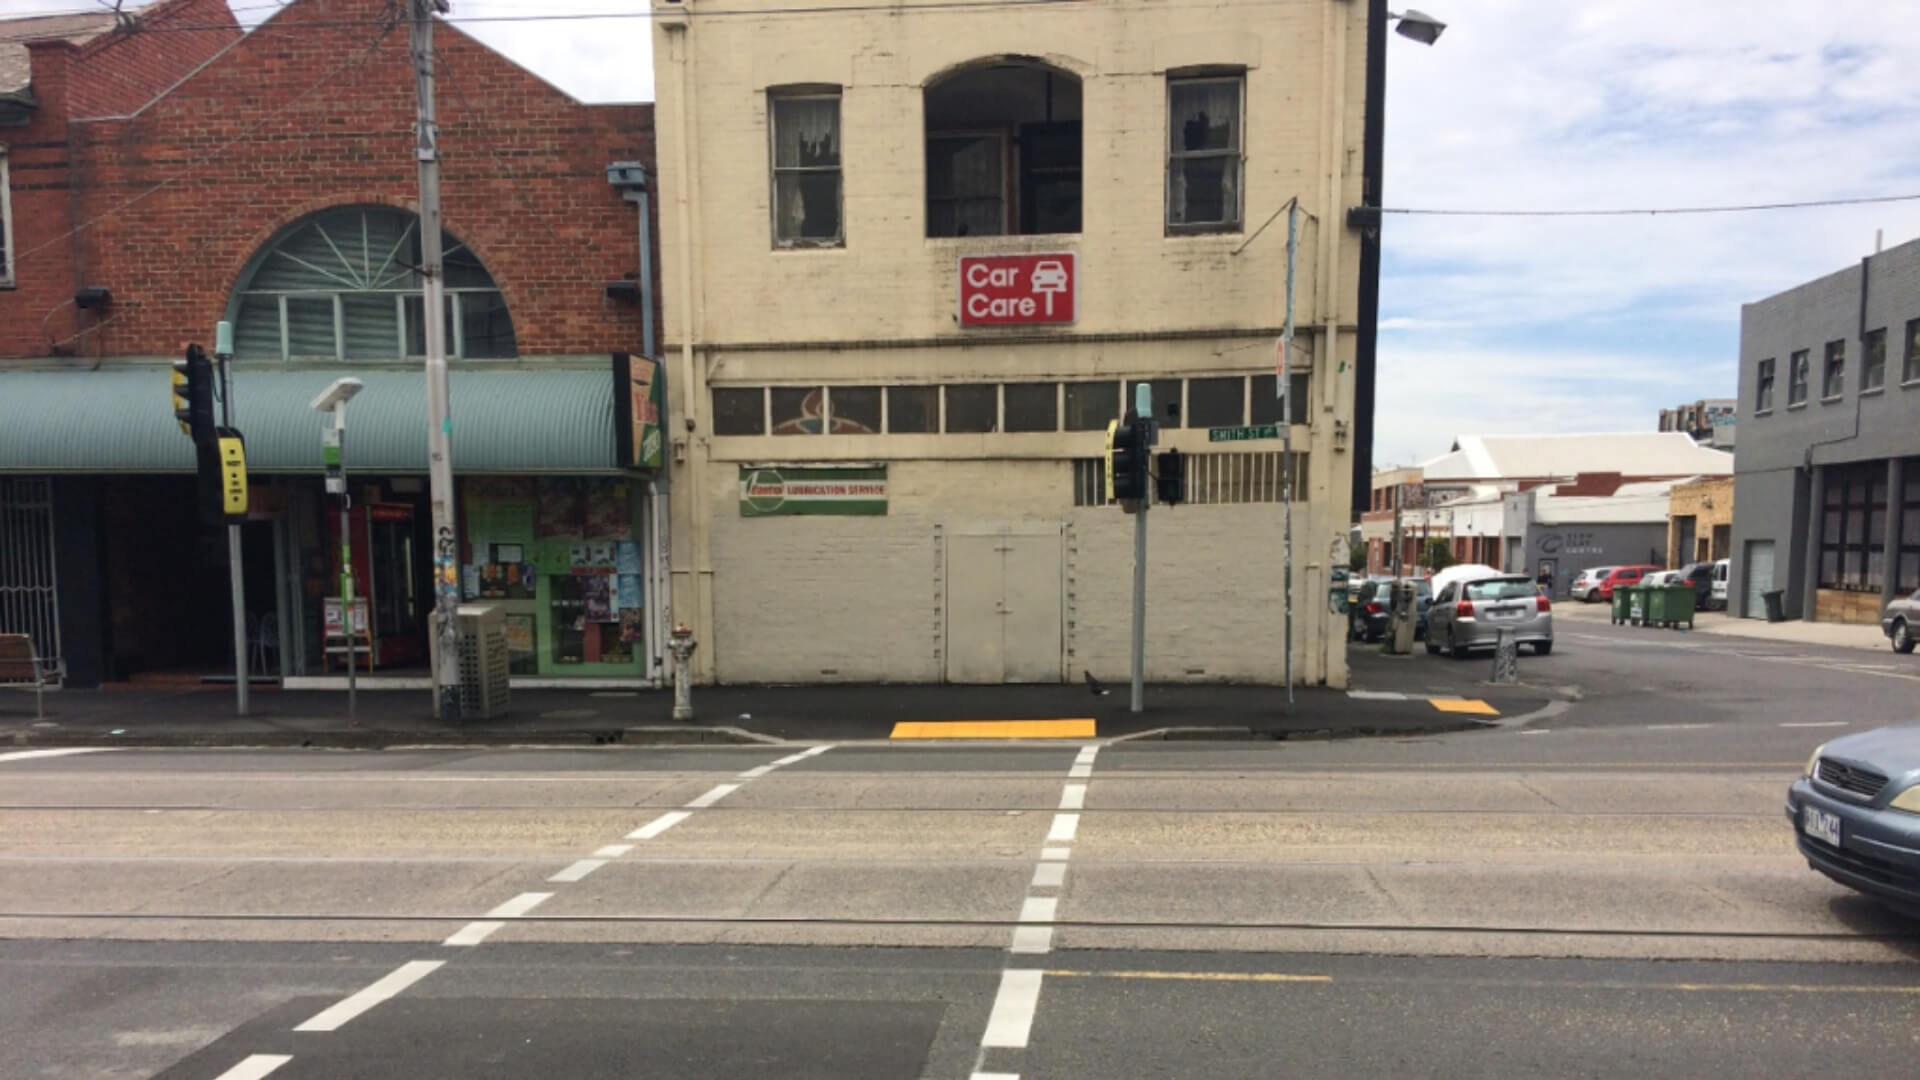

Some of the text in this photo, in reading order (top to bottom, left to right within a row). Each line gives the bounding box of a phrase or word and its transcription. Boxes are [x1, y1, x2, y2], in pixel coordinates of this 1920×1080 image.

[967, 263, 1020, 288] Car
[967, 293, 1036, 318] Care
[1211, 428, 1245, 441] SMITH
[1248, 427, 1259, 440] ST
[787, 484, 846, 496] LUBRICATION
[848, 484, 885, 496] SERVICE
